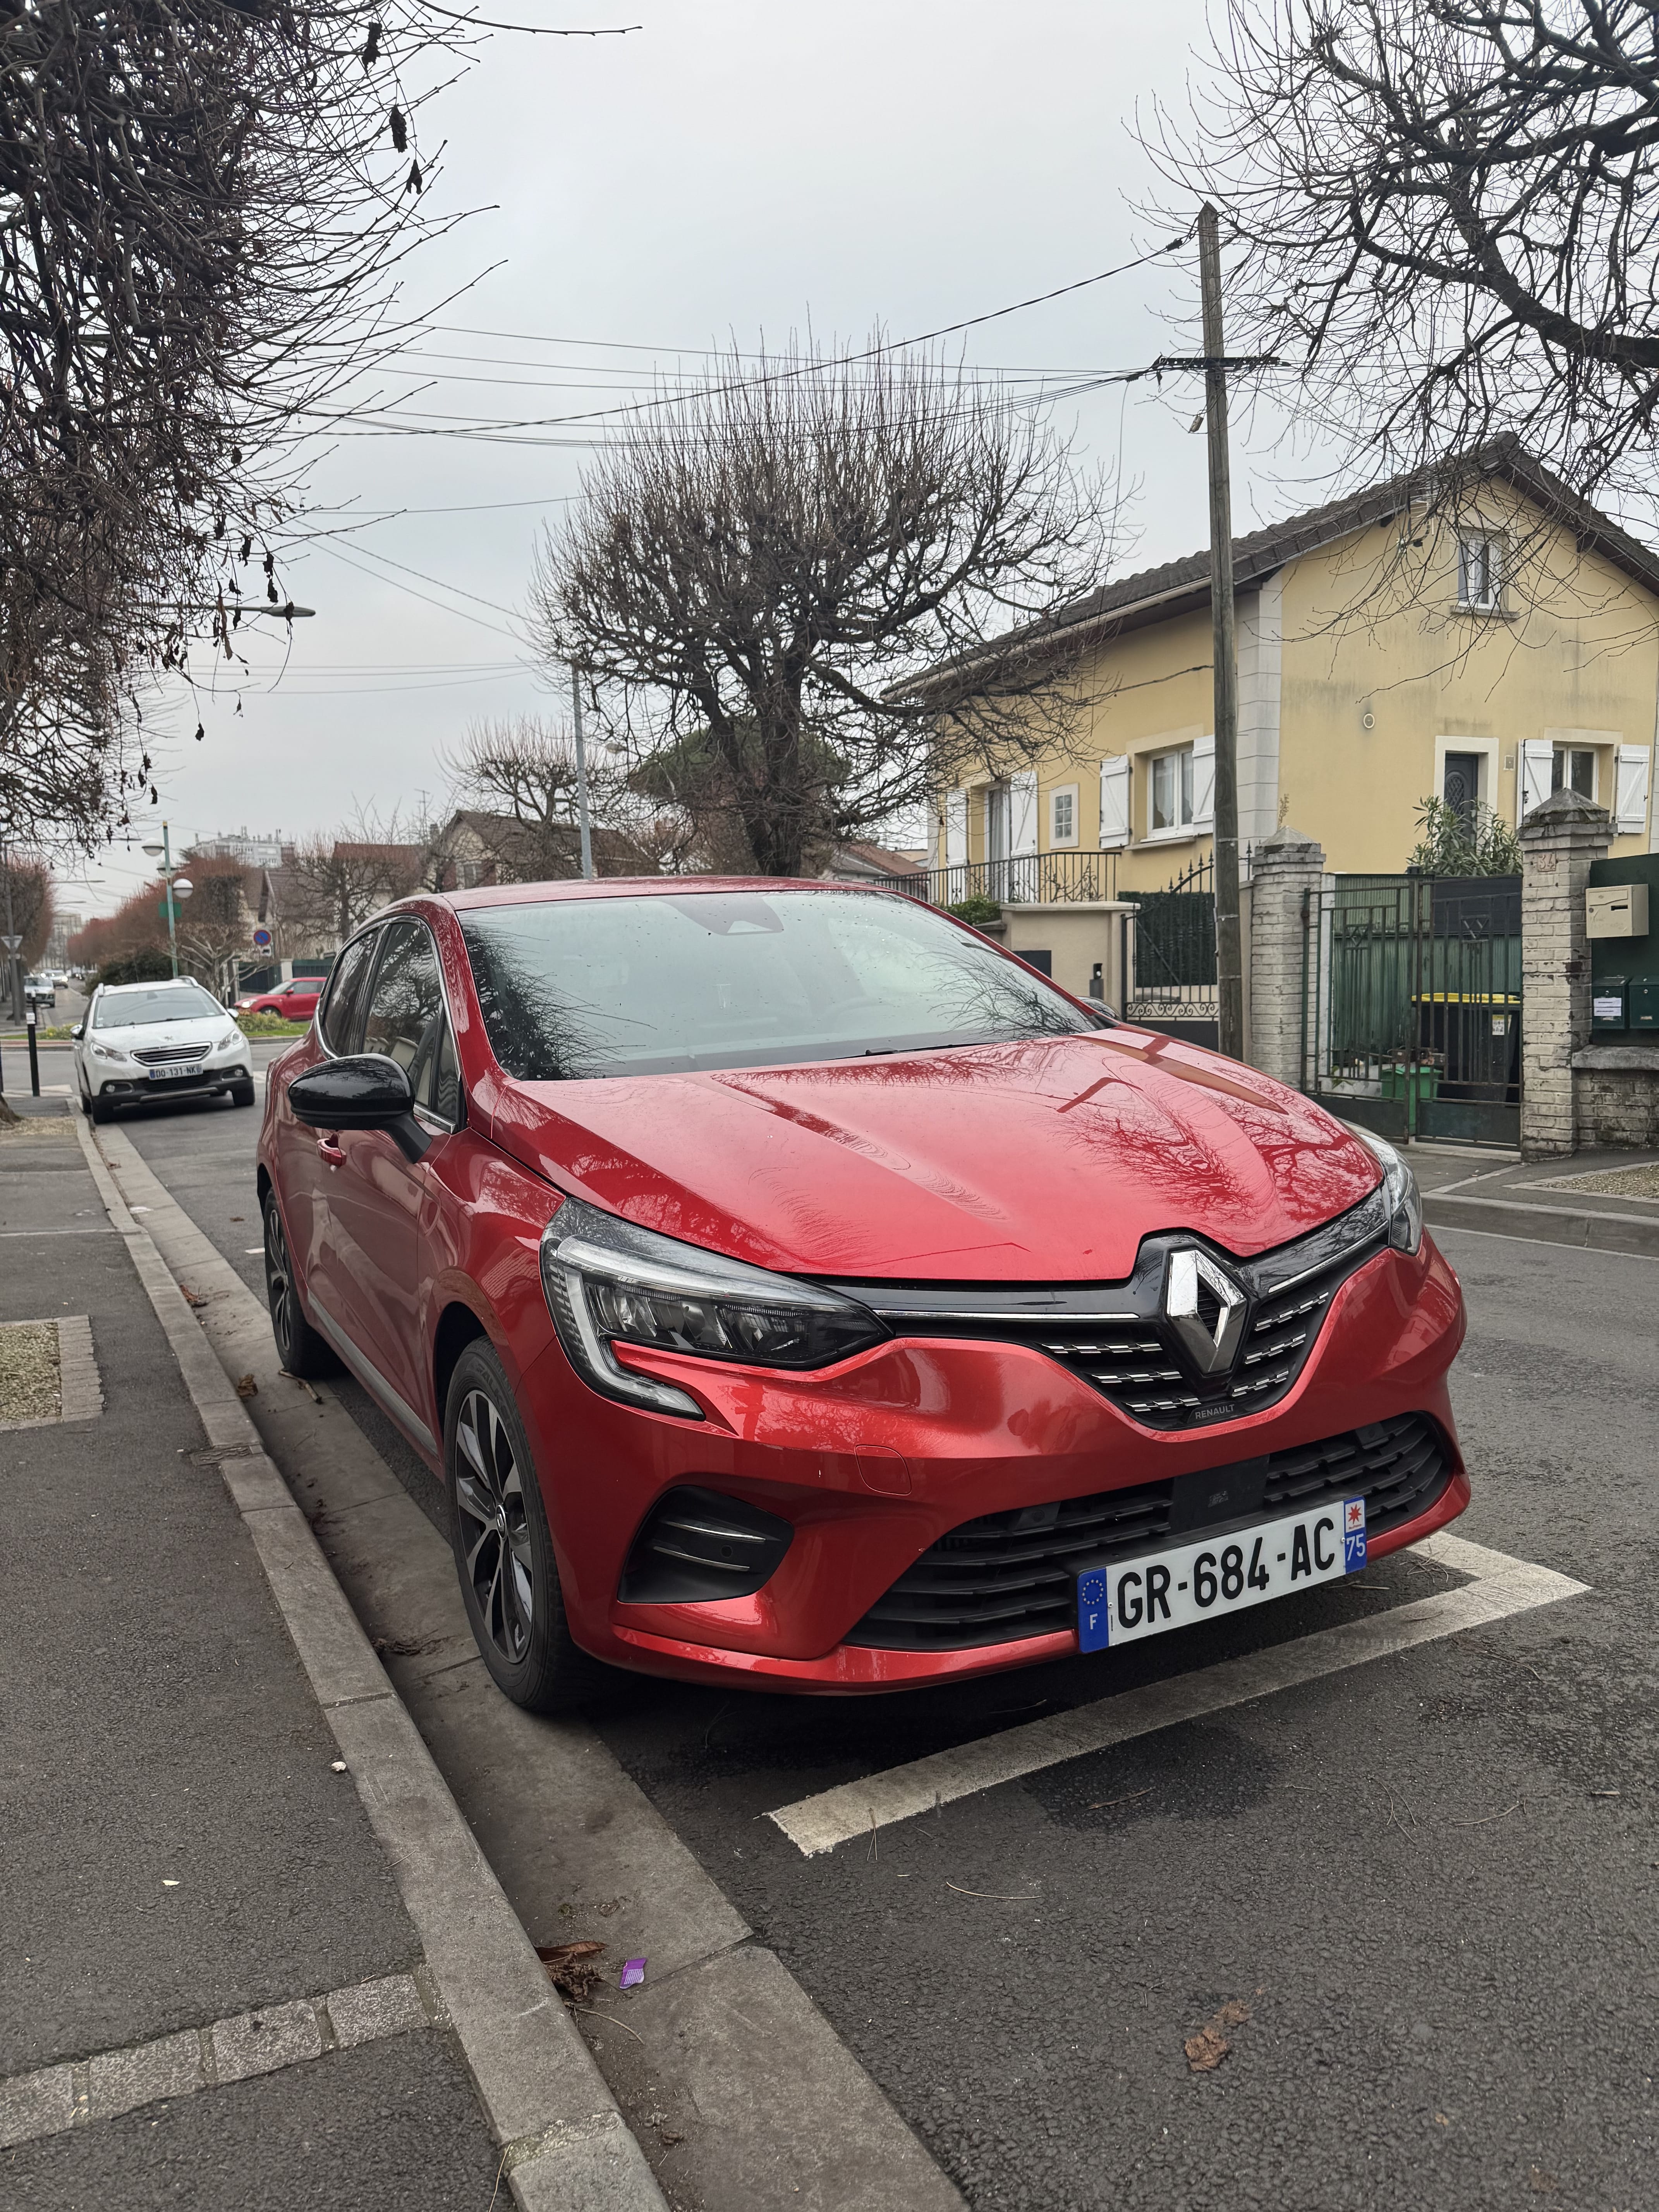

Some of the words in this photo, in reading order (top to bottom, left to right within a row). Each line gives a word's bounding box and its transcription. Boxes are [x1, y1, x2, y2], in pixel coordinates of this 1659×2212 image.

[1539, 854, 1555, 870] 34
[1195, 1404, 1235, 1419] RENAULT
[1346, 1533, 1365, 1561] 75
[1118, 1518, 1335, 1628] GR-684-AC
[1090, 1613, 1097, 1630] F
